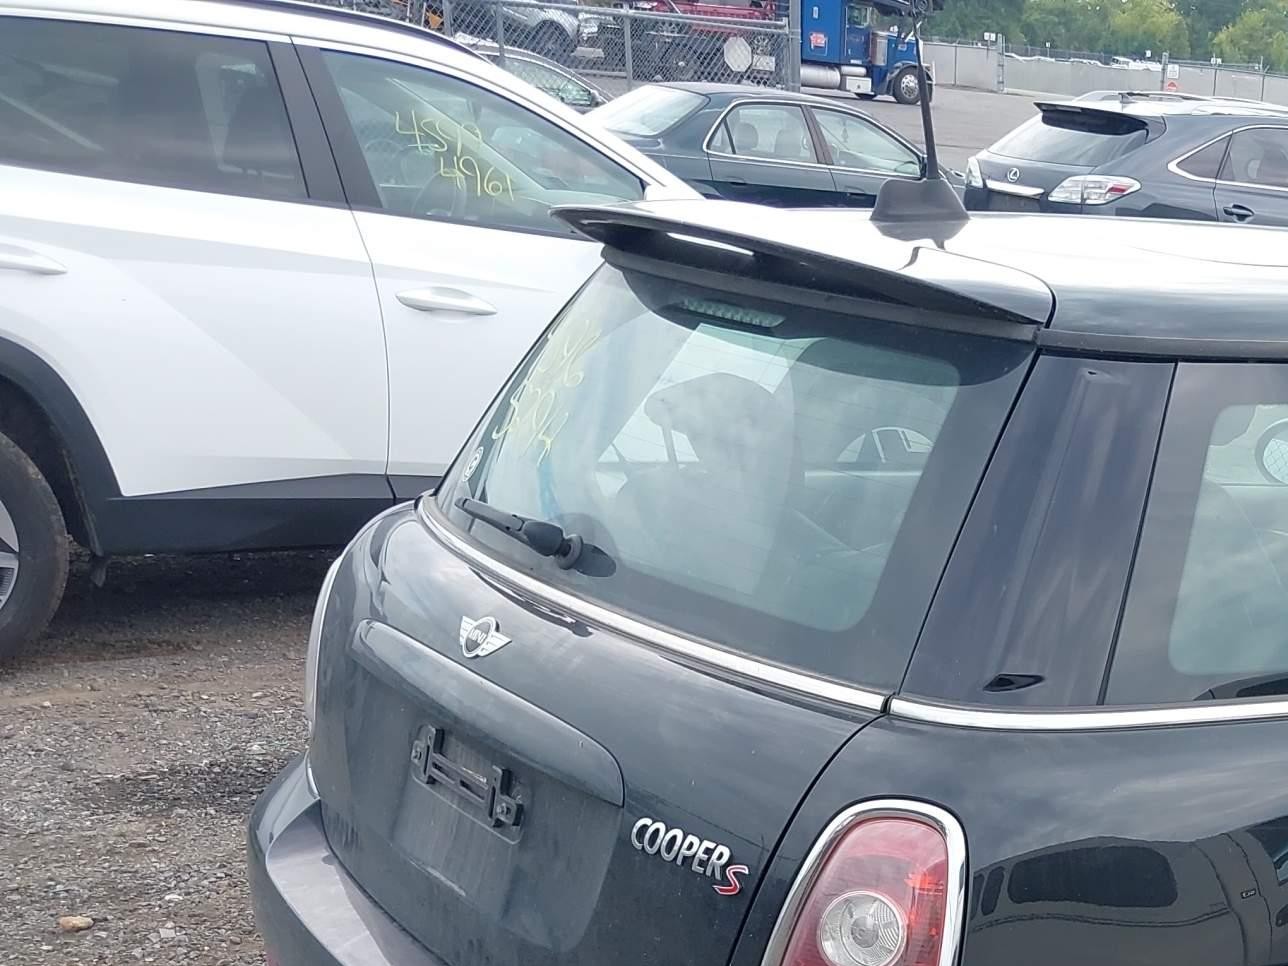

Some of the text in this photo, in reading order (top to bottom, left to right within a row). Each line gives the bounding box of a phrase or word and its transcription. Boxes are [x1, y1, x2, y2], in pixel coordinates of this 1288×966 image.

[440, 155, 514, 201] 4961
[468, 628, 488, 645] MINI
[631, 817, 749, 895] COOPER S
